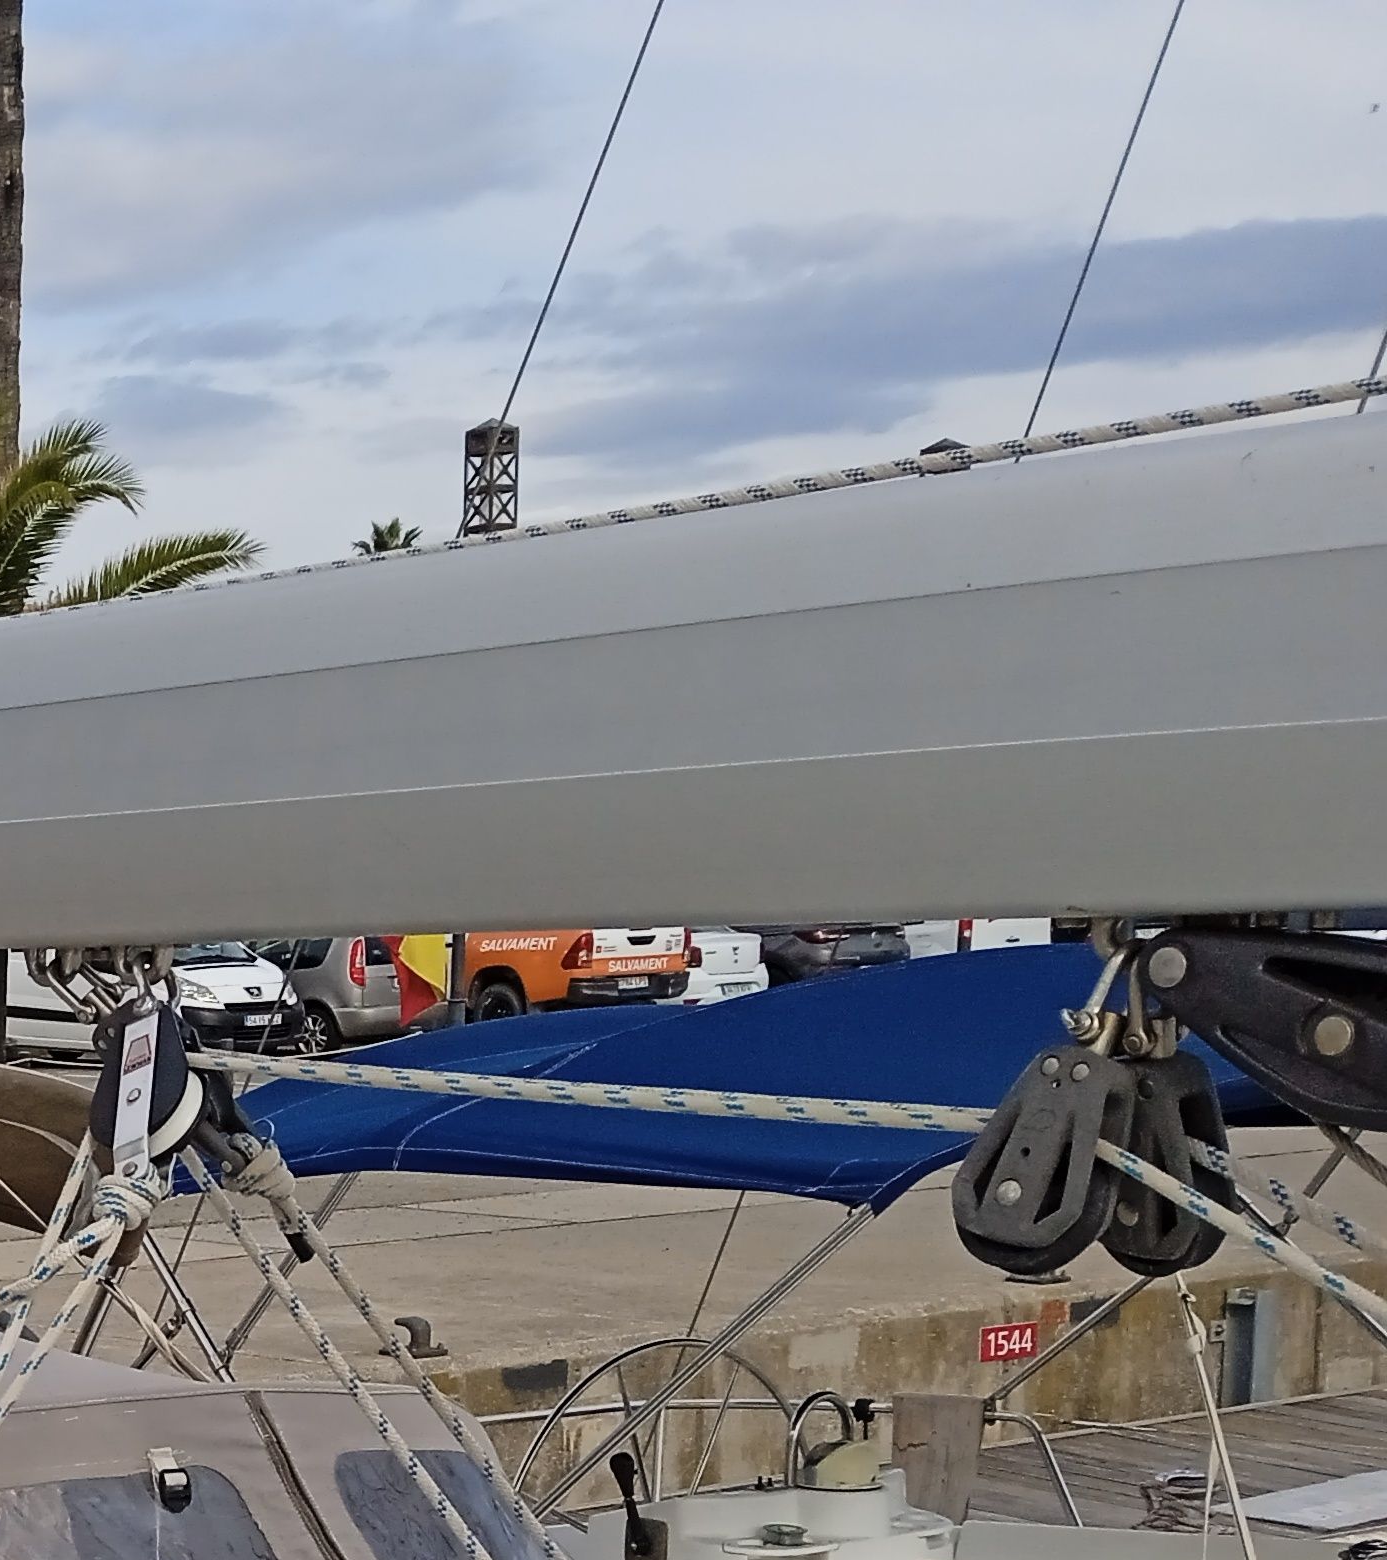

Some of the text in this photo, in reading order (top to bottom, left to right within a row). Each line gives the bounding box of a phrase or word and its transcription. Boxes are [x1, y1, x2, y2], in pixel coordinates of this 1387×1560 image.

[479, 936, 558, 953] SALVAMENT
[608, 957, 669, 973] SALVAMENT
[988, 1327, 1033, 1357] 1544
